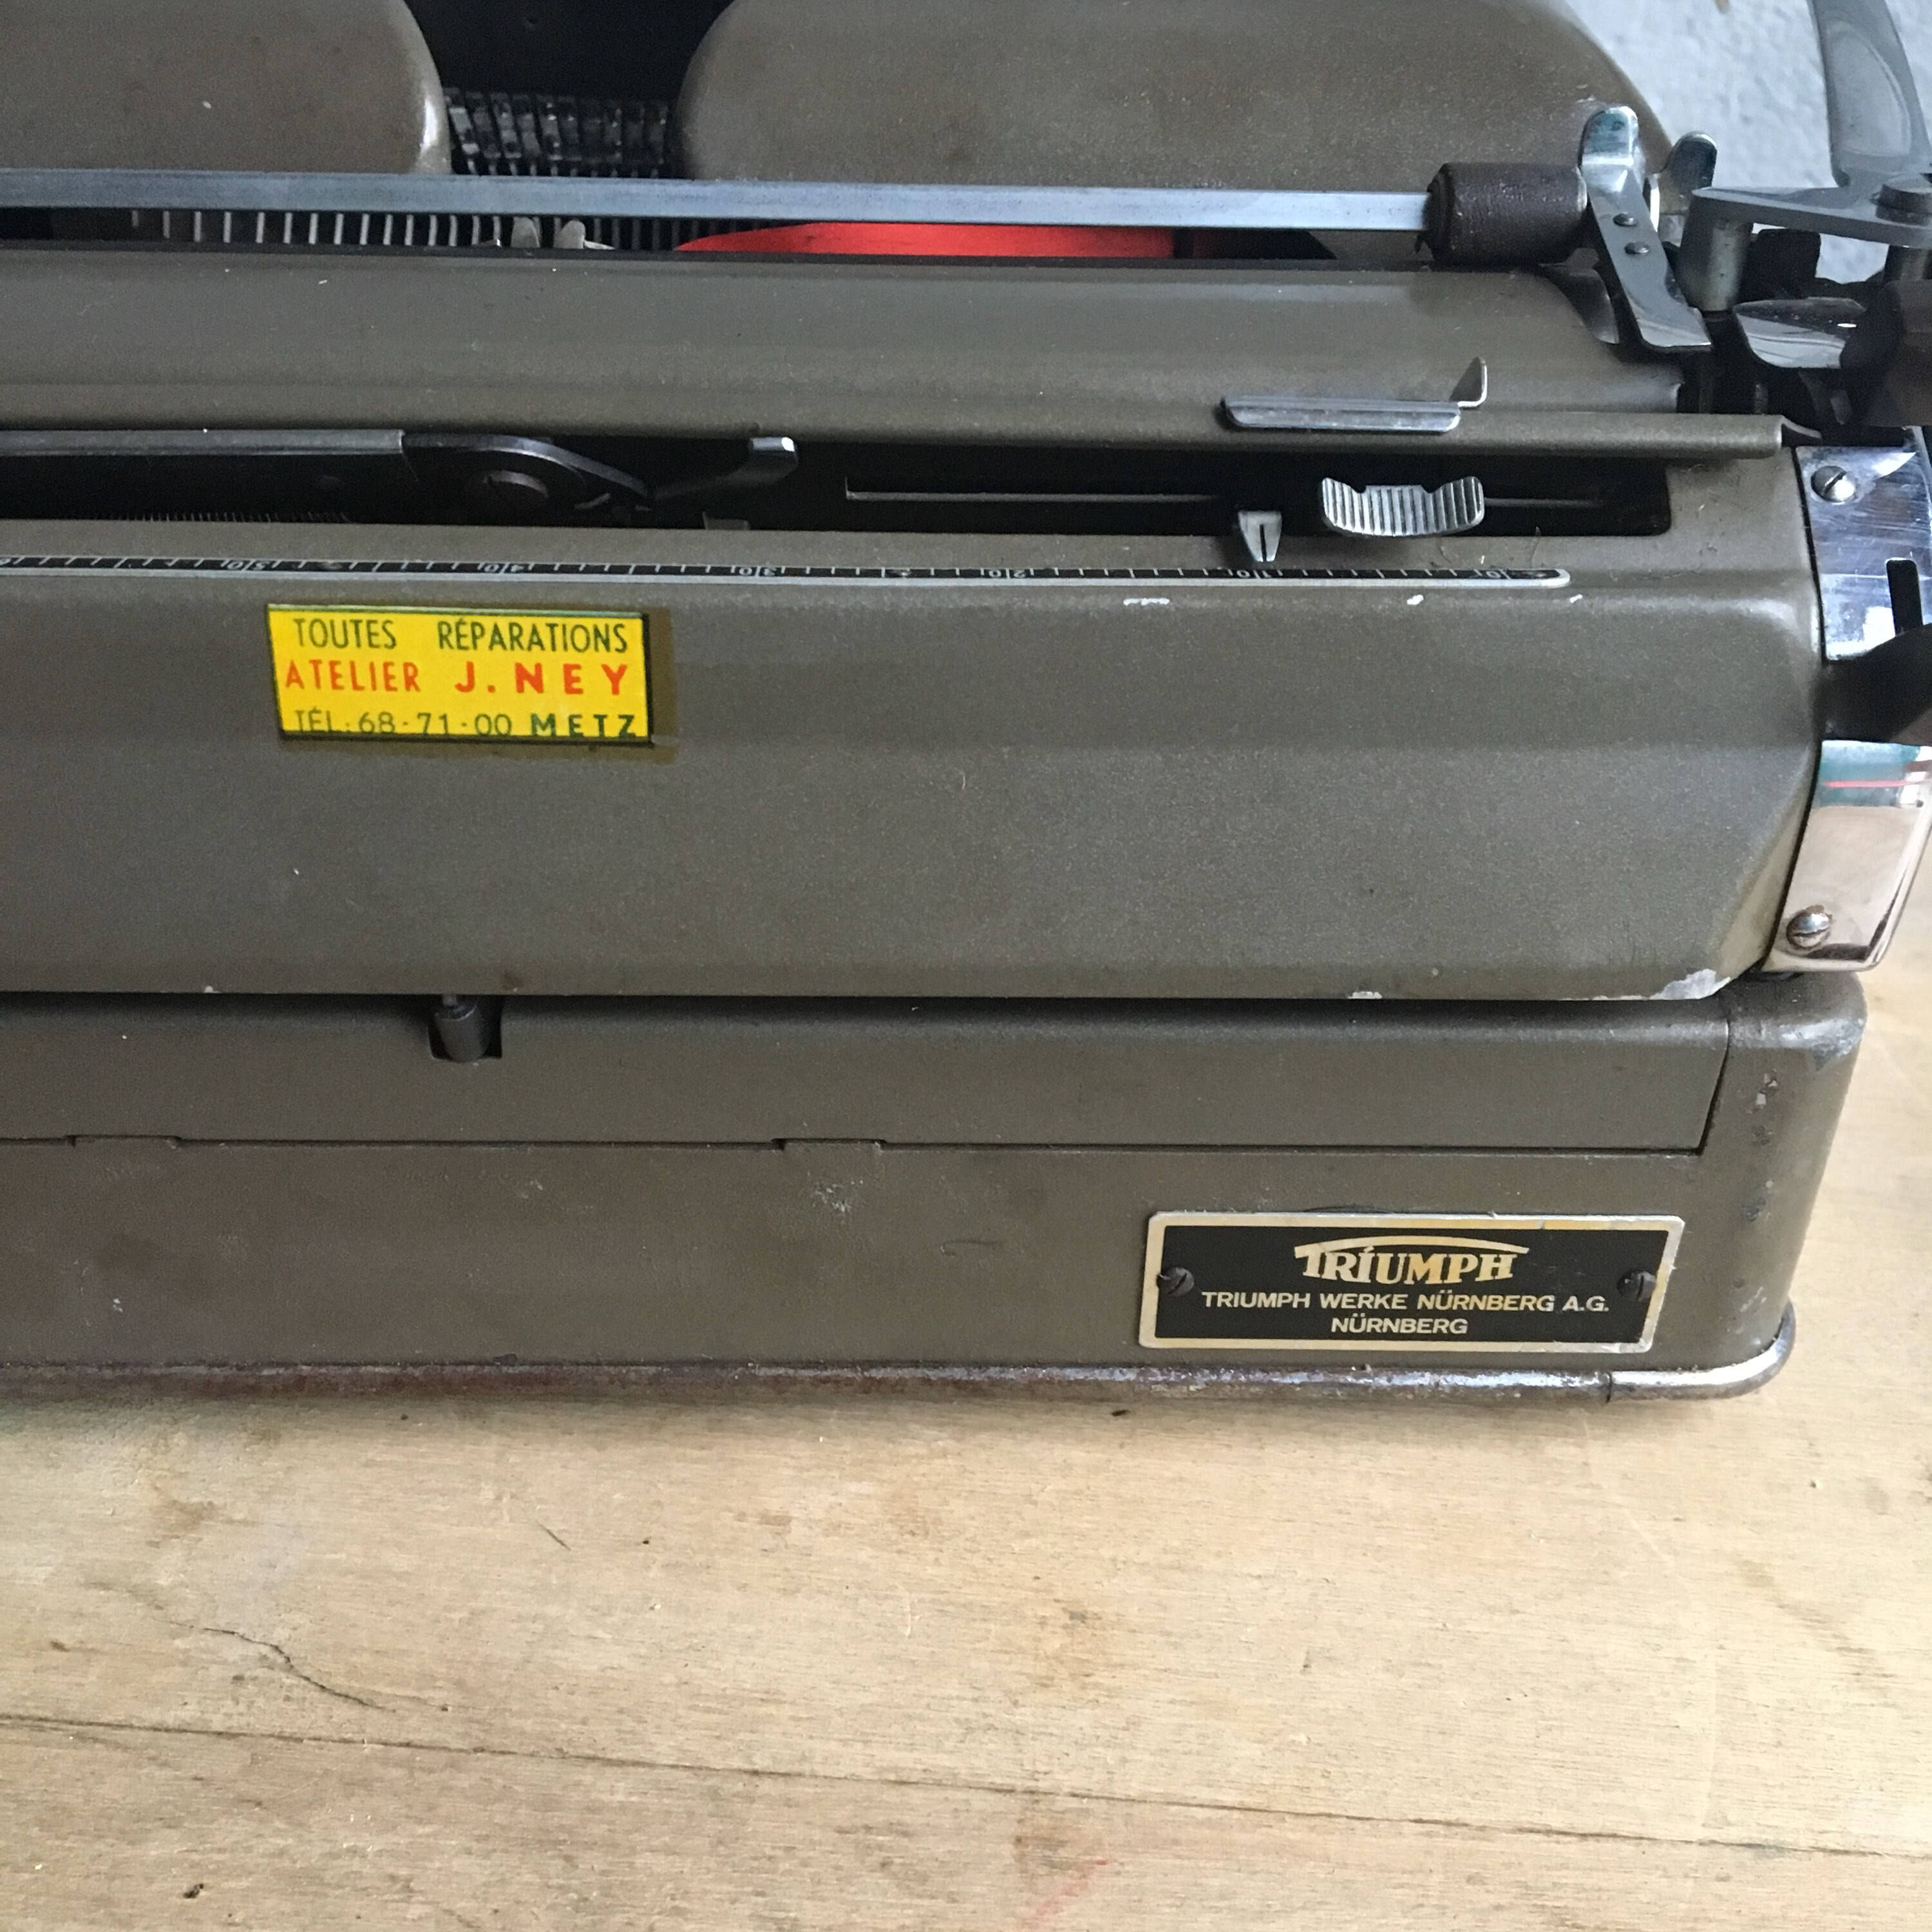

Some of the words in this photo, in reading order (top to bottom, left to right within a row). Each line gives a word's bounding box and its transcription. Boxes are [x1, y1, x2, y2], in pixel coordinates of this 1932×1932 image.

[293, 618, 397, 650] TOUTES
[437, 618, 629, 653] RÉPARATIONS
[285, 659, 421, 692] ATELIER
[530, 713, 637, 739] METZ
[1294, 1235, 1530, 1285] TRIUMPH
[1201, 1291, 1311, 1309] TRIUMPH
[1320, 1293, 1409, 1309] WERKE
[1417, 1289, 1555, 1312] NÜRNBERG
[1562, 1295, 1609, 1312] A.G.
[1331, 1313, 1468, 1334] NÜRNBERG
